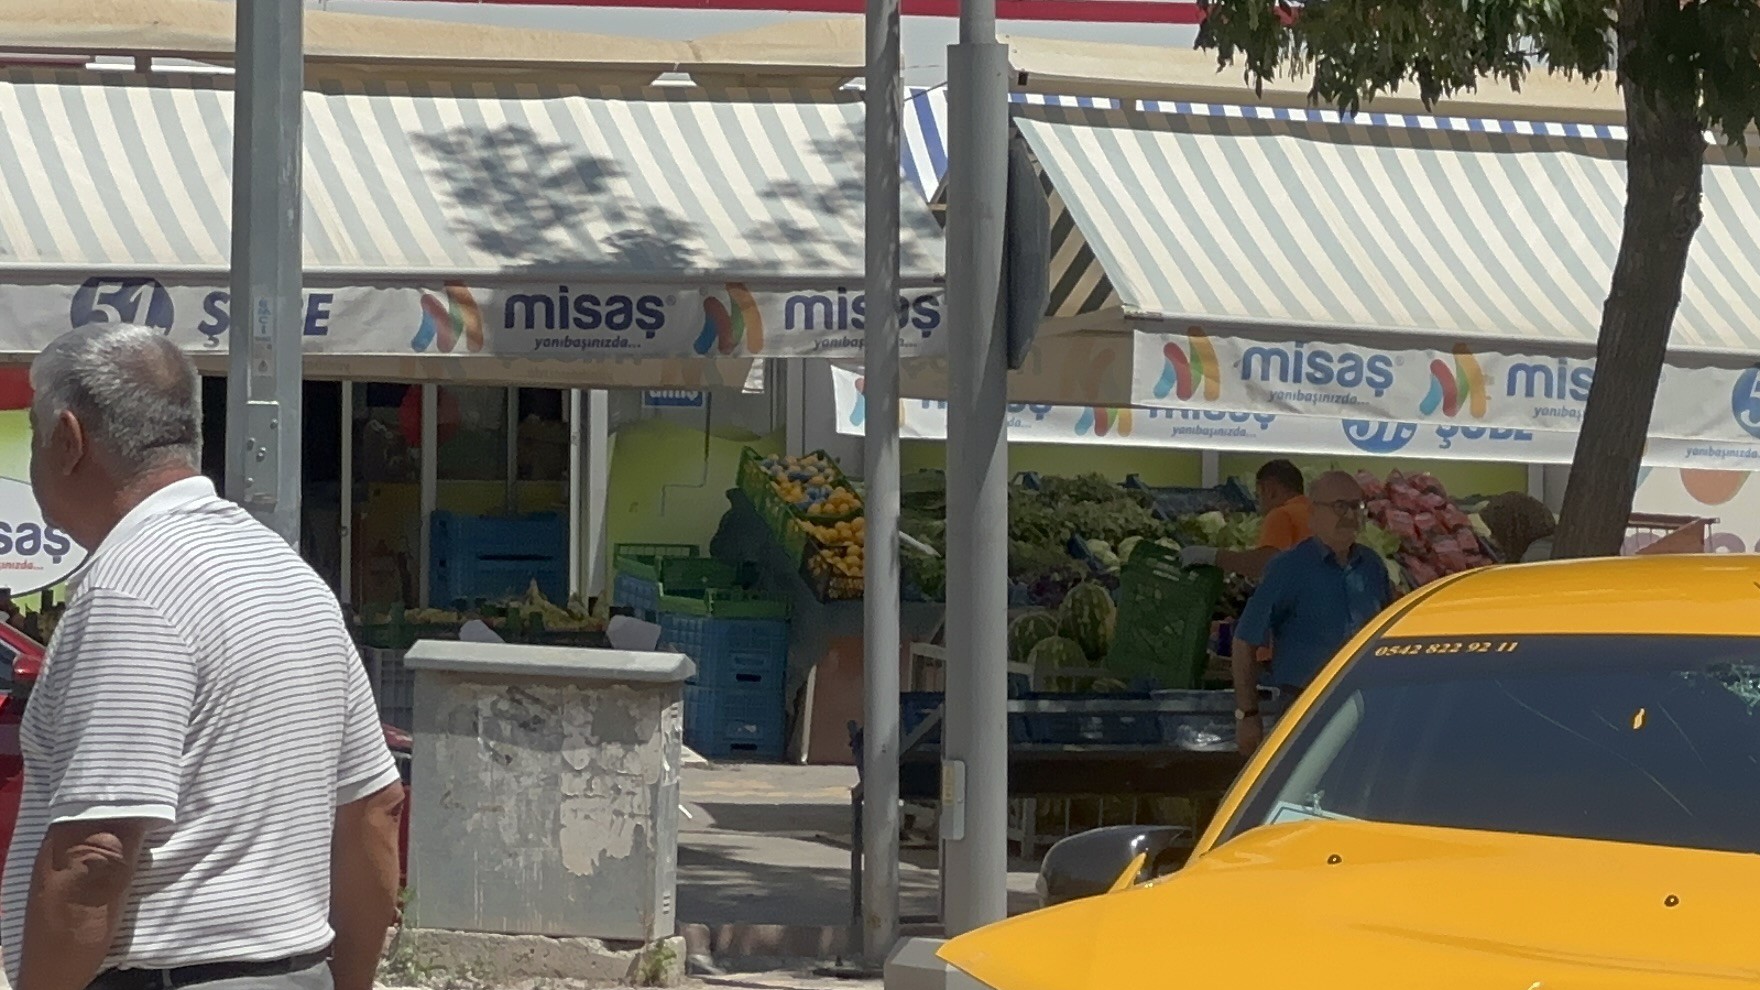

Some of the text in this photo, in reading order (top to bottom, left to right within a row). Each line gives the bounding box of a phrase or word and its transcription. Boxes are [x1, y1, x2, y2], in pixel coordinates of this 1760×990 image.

[505, 286, 665, 339] misaş
[1241, 341, 1394, 397] misaş
[1375, 642, 1518, 656] 0542 822 92 11
